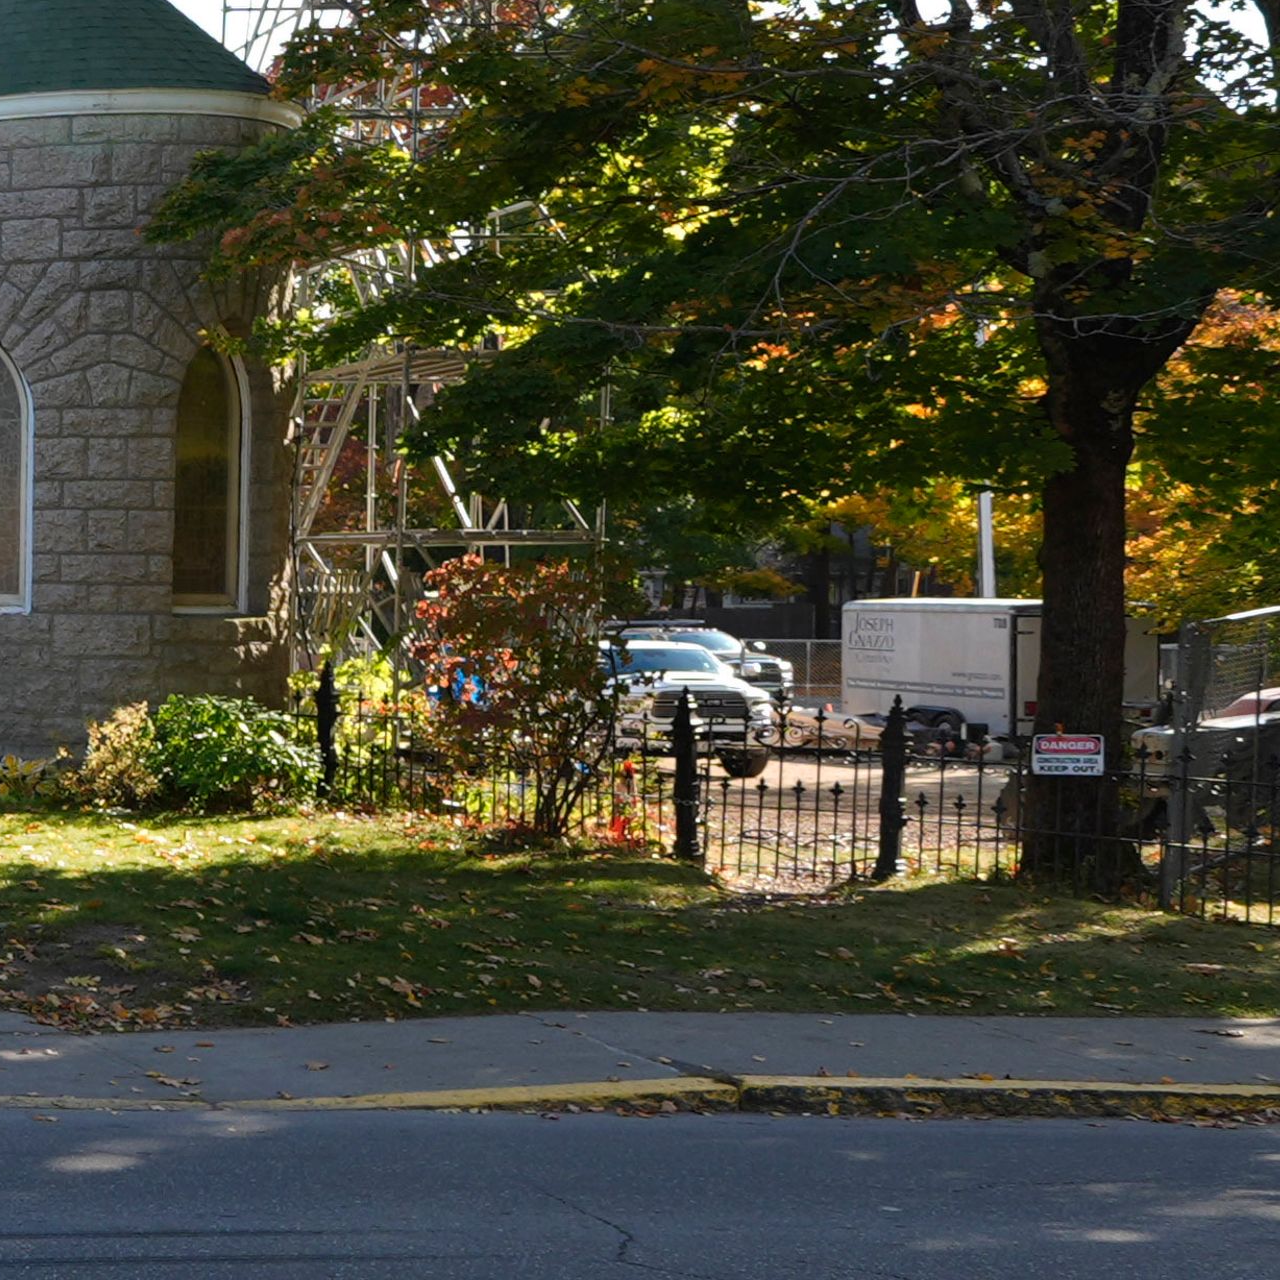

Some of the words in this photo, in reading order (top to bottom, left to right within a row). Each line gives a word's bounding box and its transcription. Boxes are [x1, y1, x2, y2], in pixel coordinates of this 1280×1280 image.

[854, 612, 894, 634] JOSEPH
[848, 630, 895, 648] GNAZZO
[1040, 741, 1095, 750] DANGER
[1072, 765, 1096, 773] OUT
